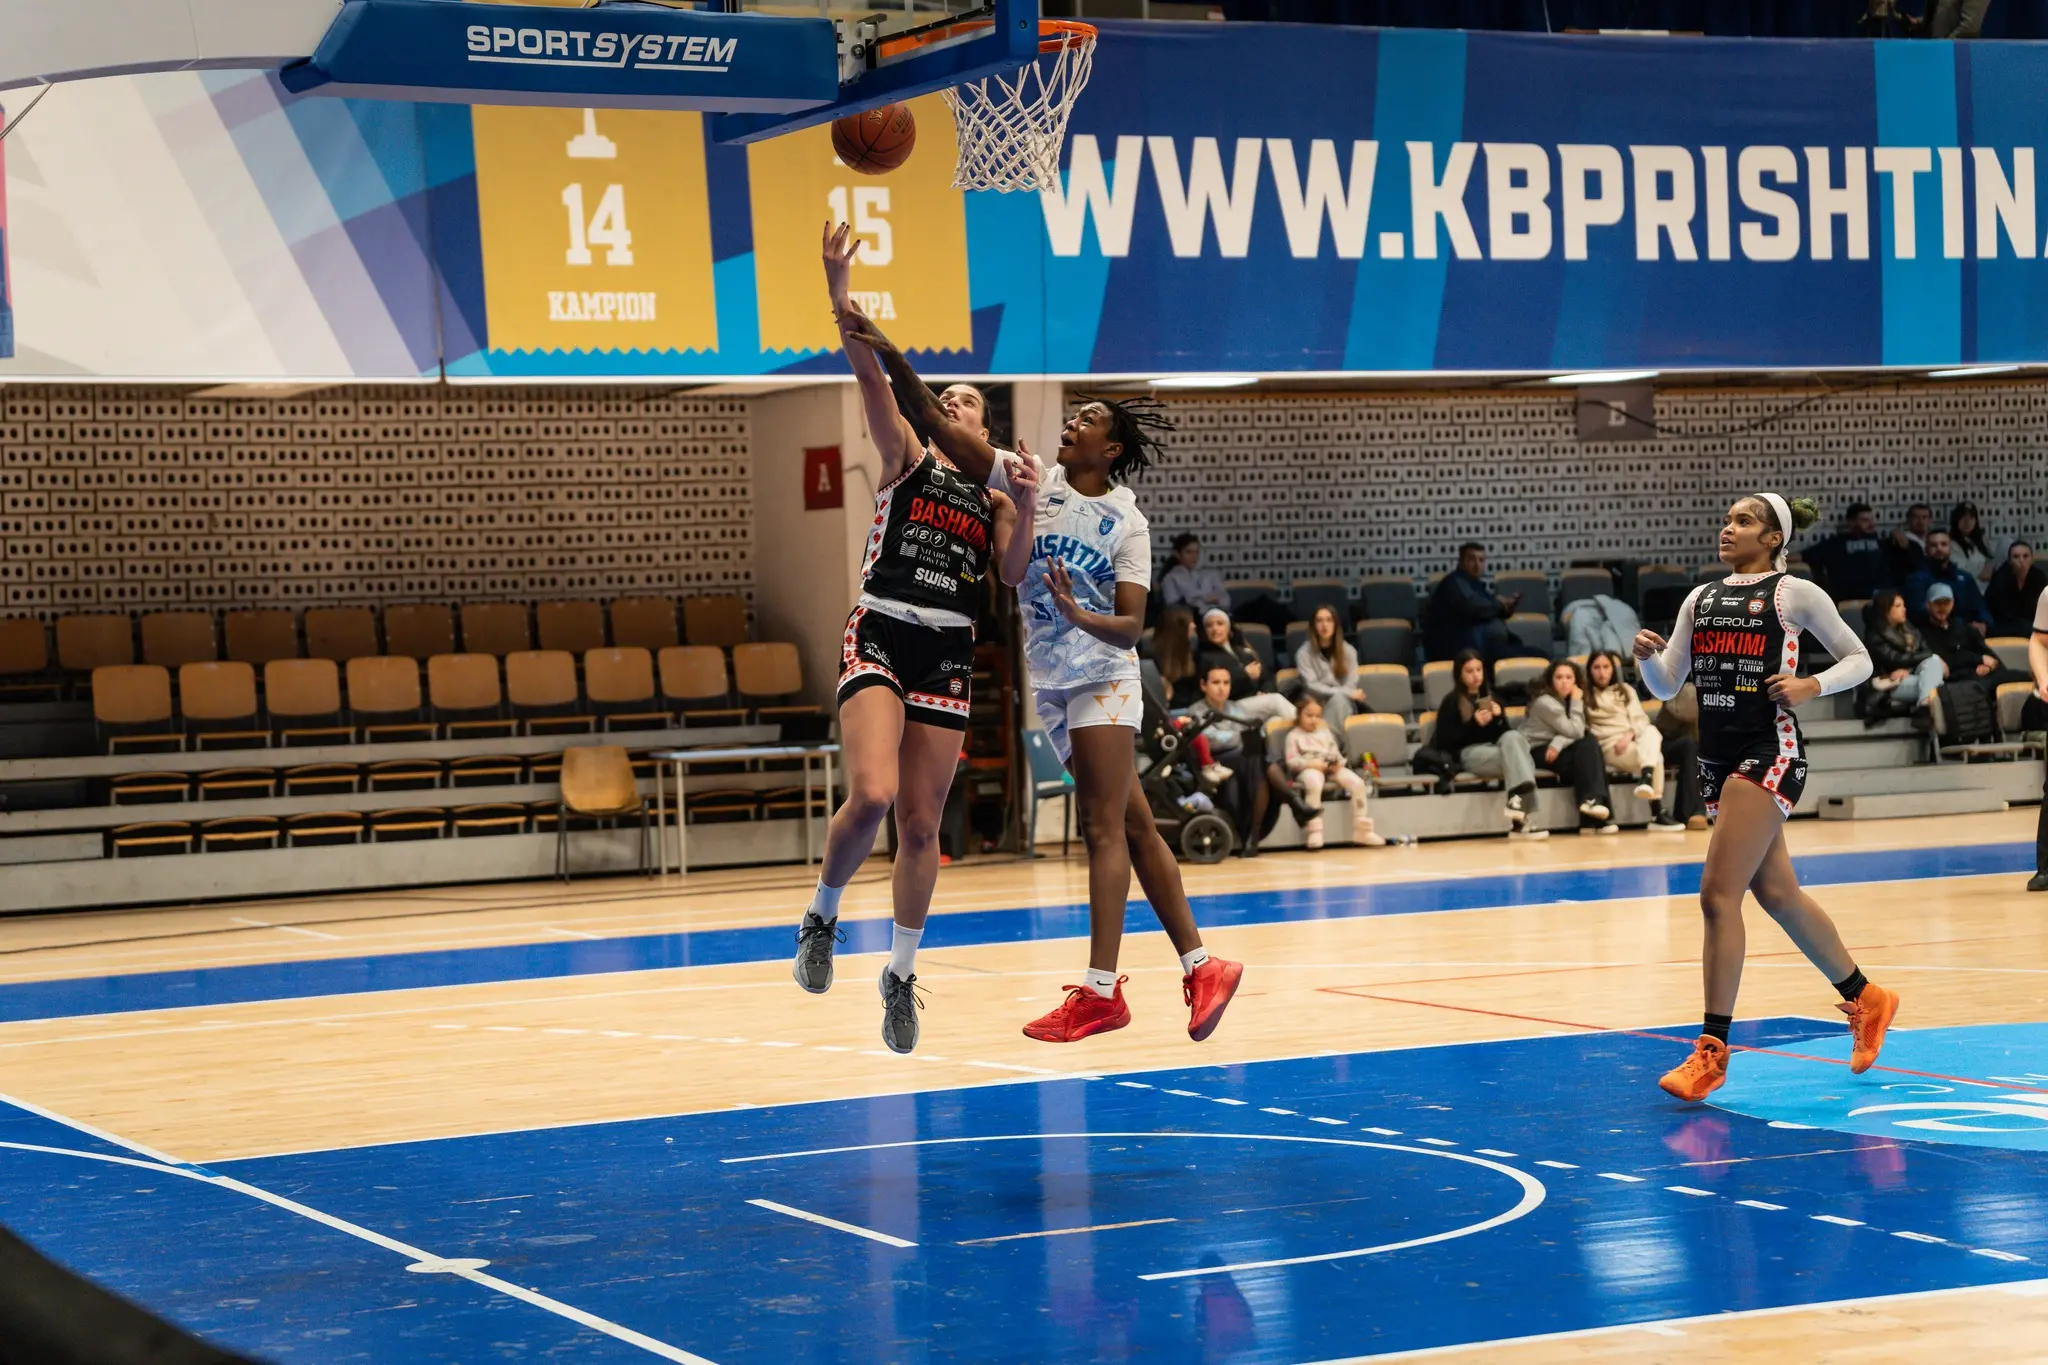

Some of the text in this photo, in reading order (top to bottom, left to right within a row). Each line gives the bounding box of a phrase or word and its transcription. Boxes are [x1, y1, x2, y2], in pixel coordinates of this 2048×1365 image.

[466, 25, 738, 68] SPORTSYSTEM
[1037, 134, 2048, 261] WWW.KBPRISHTIN
[562, 183, 634, 265] 14
[828, 186, 893, 266] 15
[547, 291, 656, 321] KAMPION
[848, 291, 898, 320] UPA
[818, 463, 832, 492] A
[922, 484, 947, 499] FAT
[914, 567, 958, 592] swiss
[1707, 589, 1717, 598] 2
[1695, 616, 1763, 628] FAT GROUP
[1736, 674, 1758, 687] flux
[1702, 691, 1735, 708] swiss
